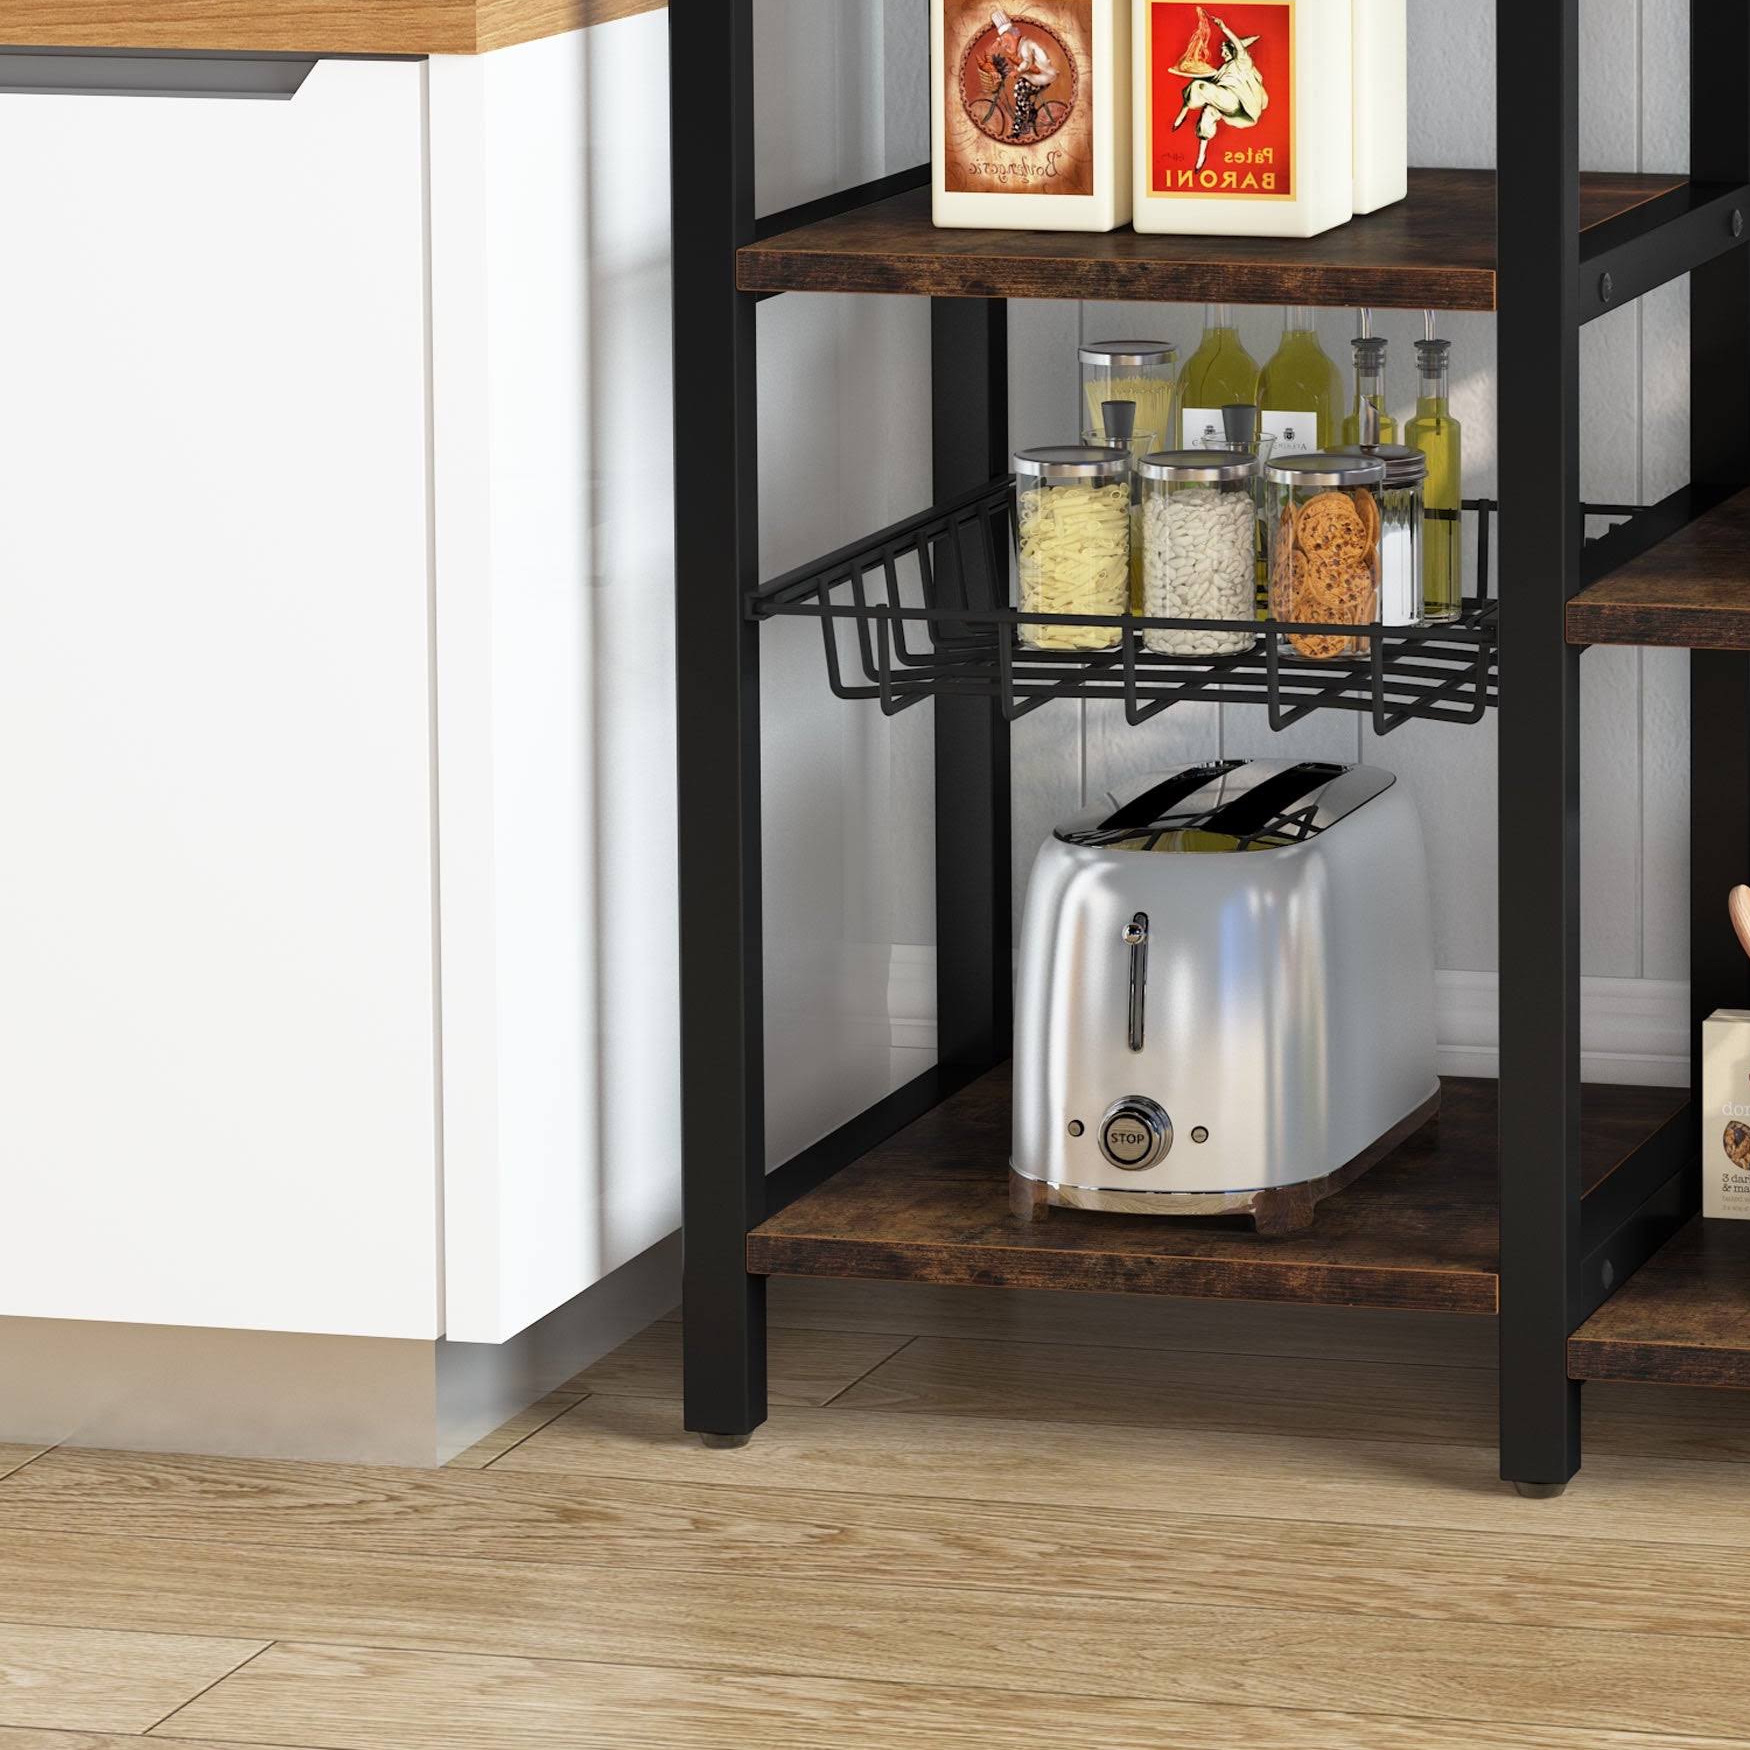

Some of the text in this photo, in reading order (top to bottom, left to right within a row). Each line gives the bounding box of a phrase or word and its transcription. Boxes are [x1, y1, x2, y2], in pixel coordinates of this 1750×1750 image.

[1111, 1132, 1145, 1145] STOP
[1722, 1173, 1730, 1183] 3
[1722, 1183, 1732, 1193] &
